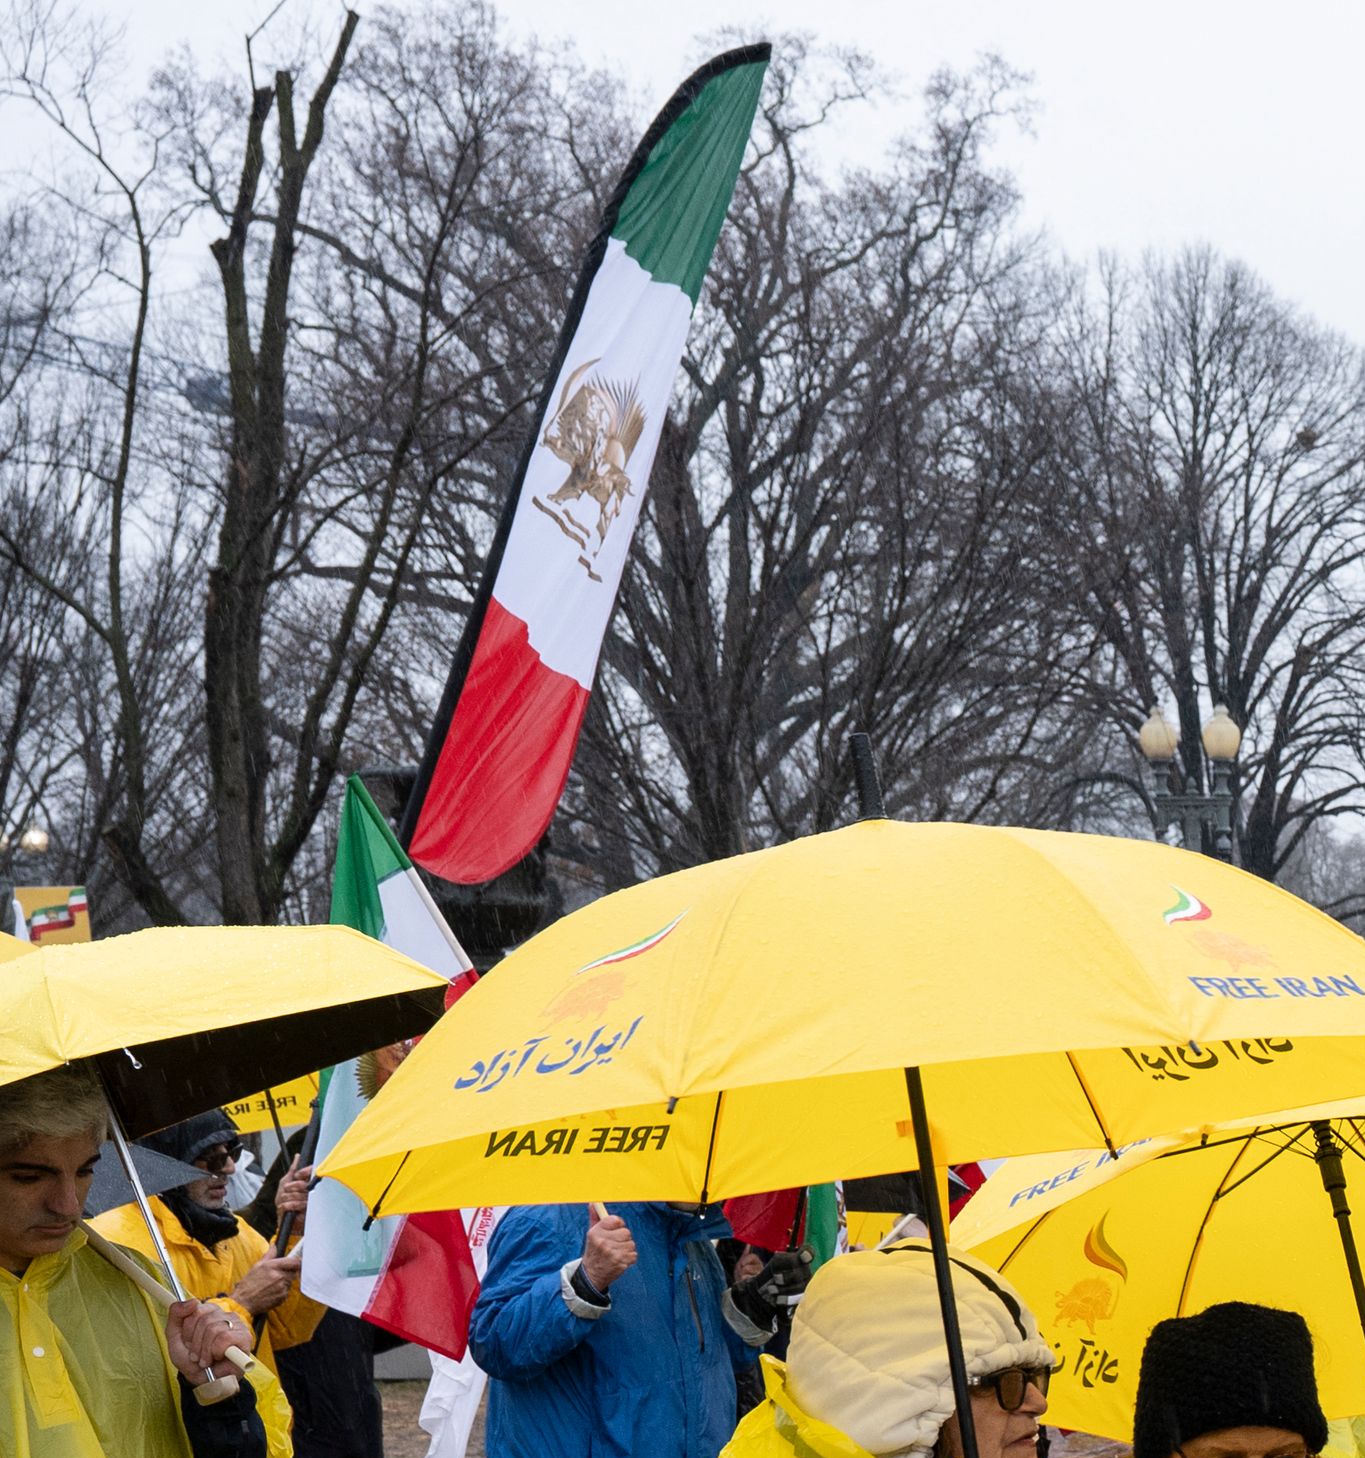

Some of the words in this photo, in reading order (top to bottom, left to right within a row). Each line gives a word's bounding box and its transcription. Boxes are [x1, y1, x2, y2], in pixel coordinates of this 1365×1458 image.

[1187, 975, 1280, 1000] FREE
[454, 1035, 551, 1093] آزاد
[536, 1015, 644, 1075] ایران
[1009, 1161, 1090, 1208] FREE
